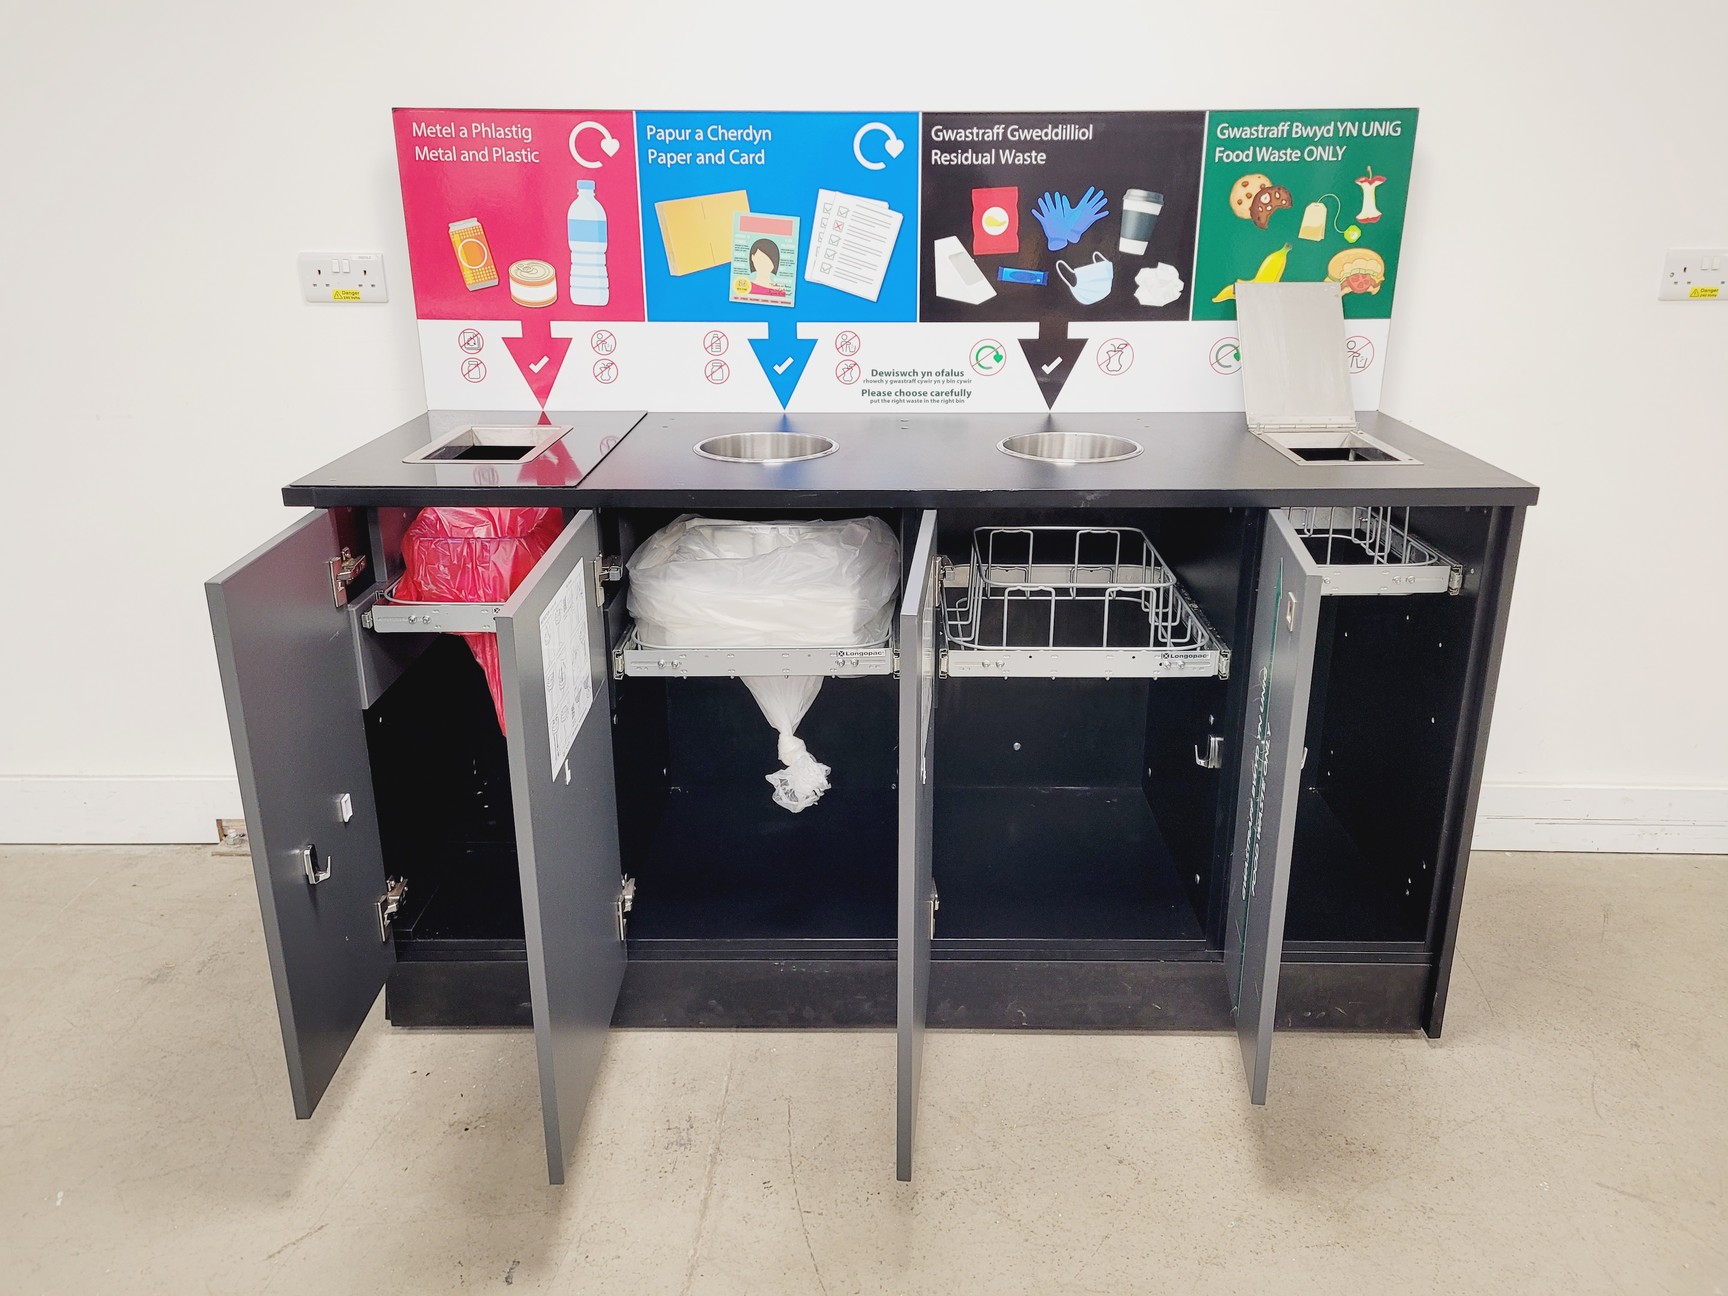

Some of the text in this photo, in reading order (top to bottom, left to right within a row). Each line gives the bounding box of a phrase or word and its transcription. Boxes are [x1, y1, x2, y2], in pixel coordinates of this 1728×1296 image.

[412, 121, 532, 143] Metel a Phlastig
[647, 125, 772, 145] Papur a Cherdyn
[931, 123, 1094, 141] Gwastraff Gweddilliol
[1216, 120, 1402, 142] Gwastraff Bwyd YN UNIG
[415, 145, 540, 163] Metal and Plastic
[648, 149, 766, 168] Paper and Card
[931, 148, 1047, 165] Residual Waste
[1214, 145, 1347, 163] Food Waste ONLY
[871, 369, 965, 379] Dewiswch yn ofalus
[861, 389, 972, 399] Please choose carefully
[1251, 843, 1260, 897] FOOD
[1257, 778, 1266, 840] WASTE
